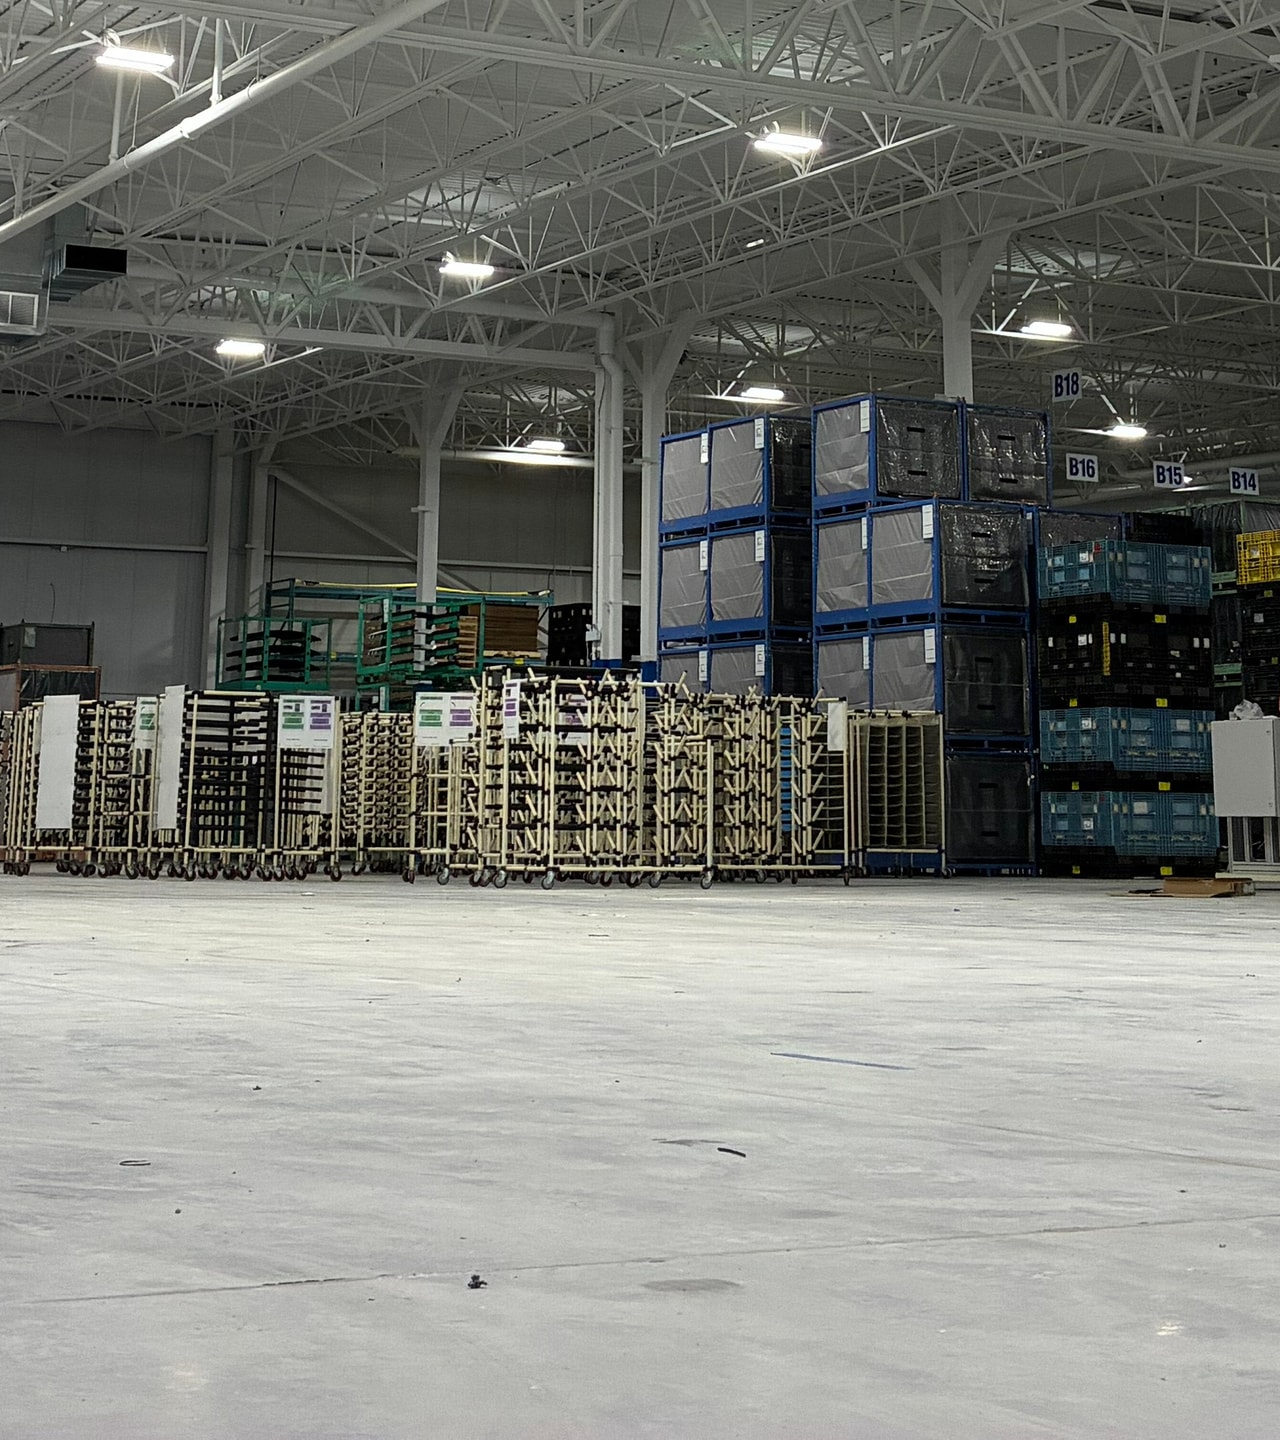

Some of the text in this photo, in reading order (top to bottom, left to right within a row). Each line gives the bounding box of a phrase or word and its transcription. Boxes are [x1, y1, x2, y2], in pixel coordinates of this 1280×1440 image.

[1054, 372, 1080, 398] B18
[1069, 457, 1096, 478] B16
[1155, 464, 1182, 485] B15
[1231, 471, 1257, 491] B14
